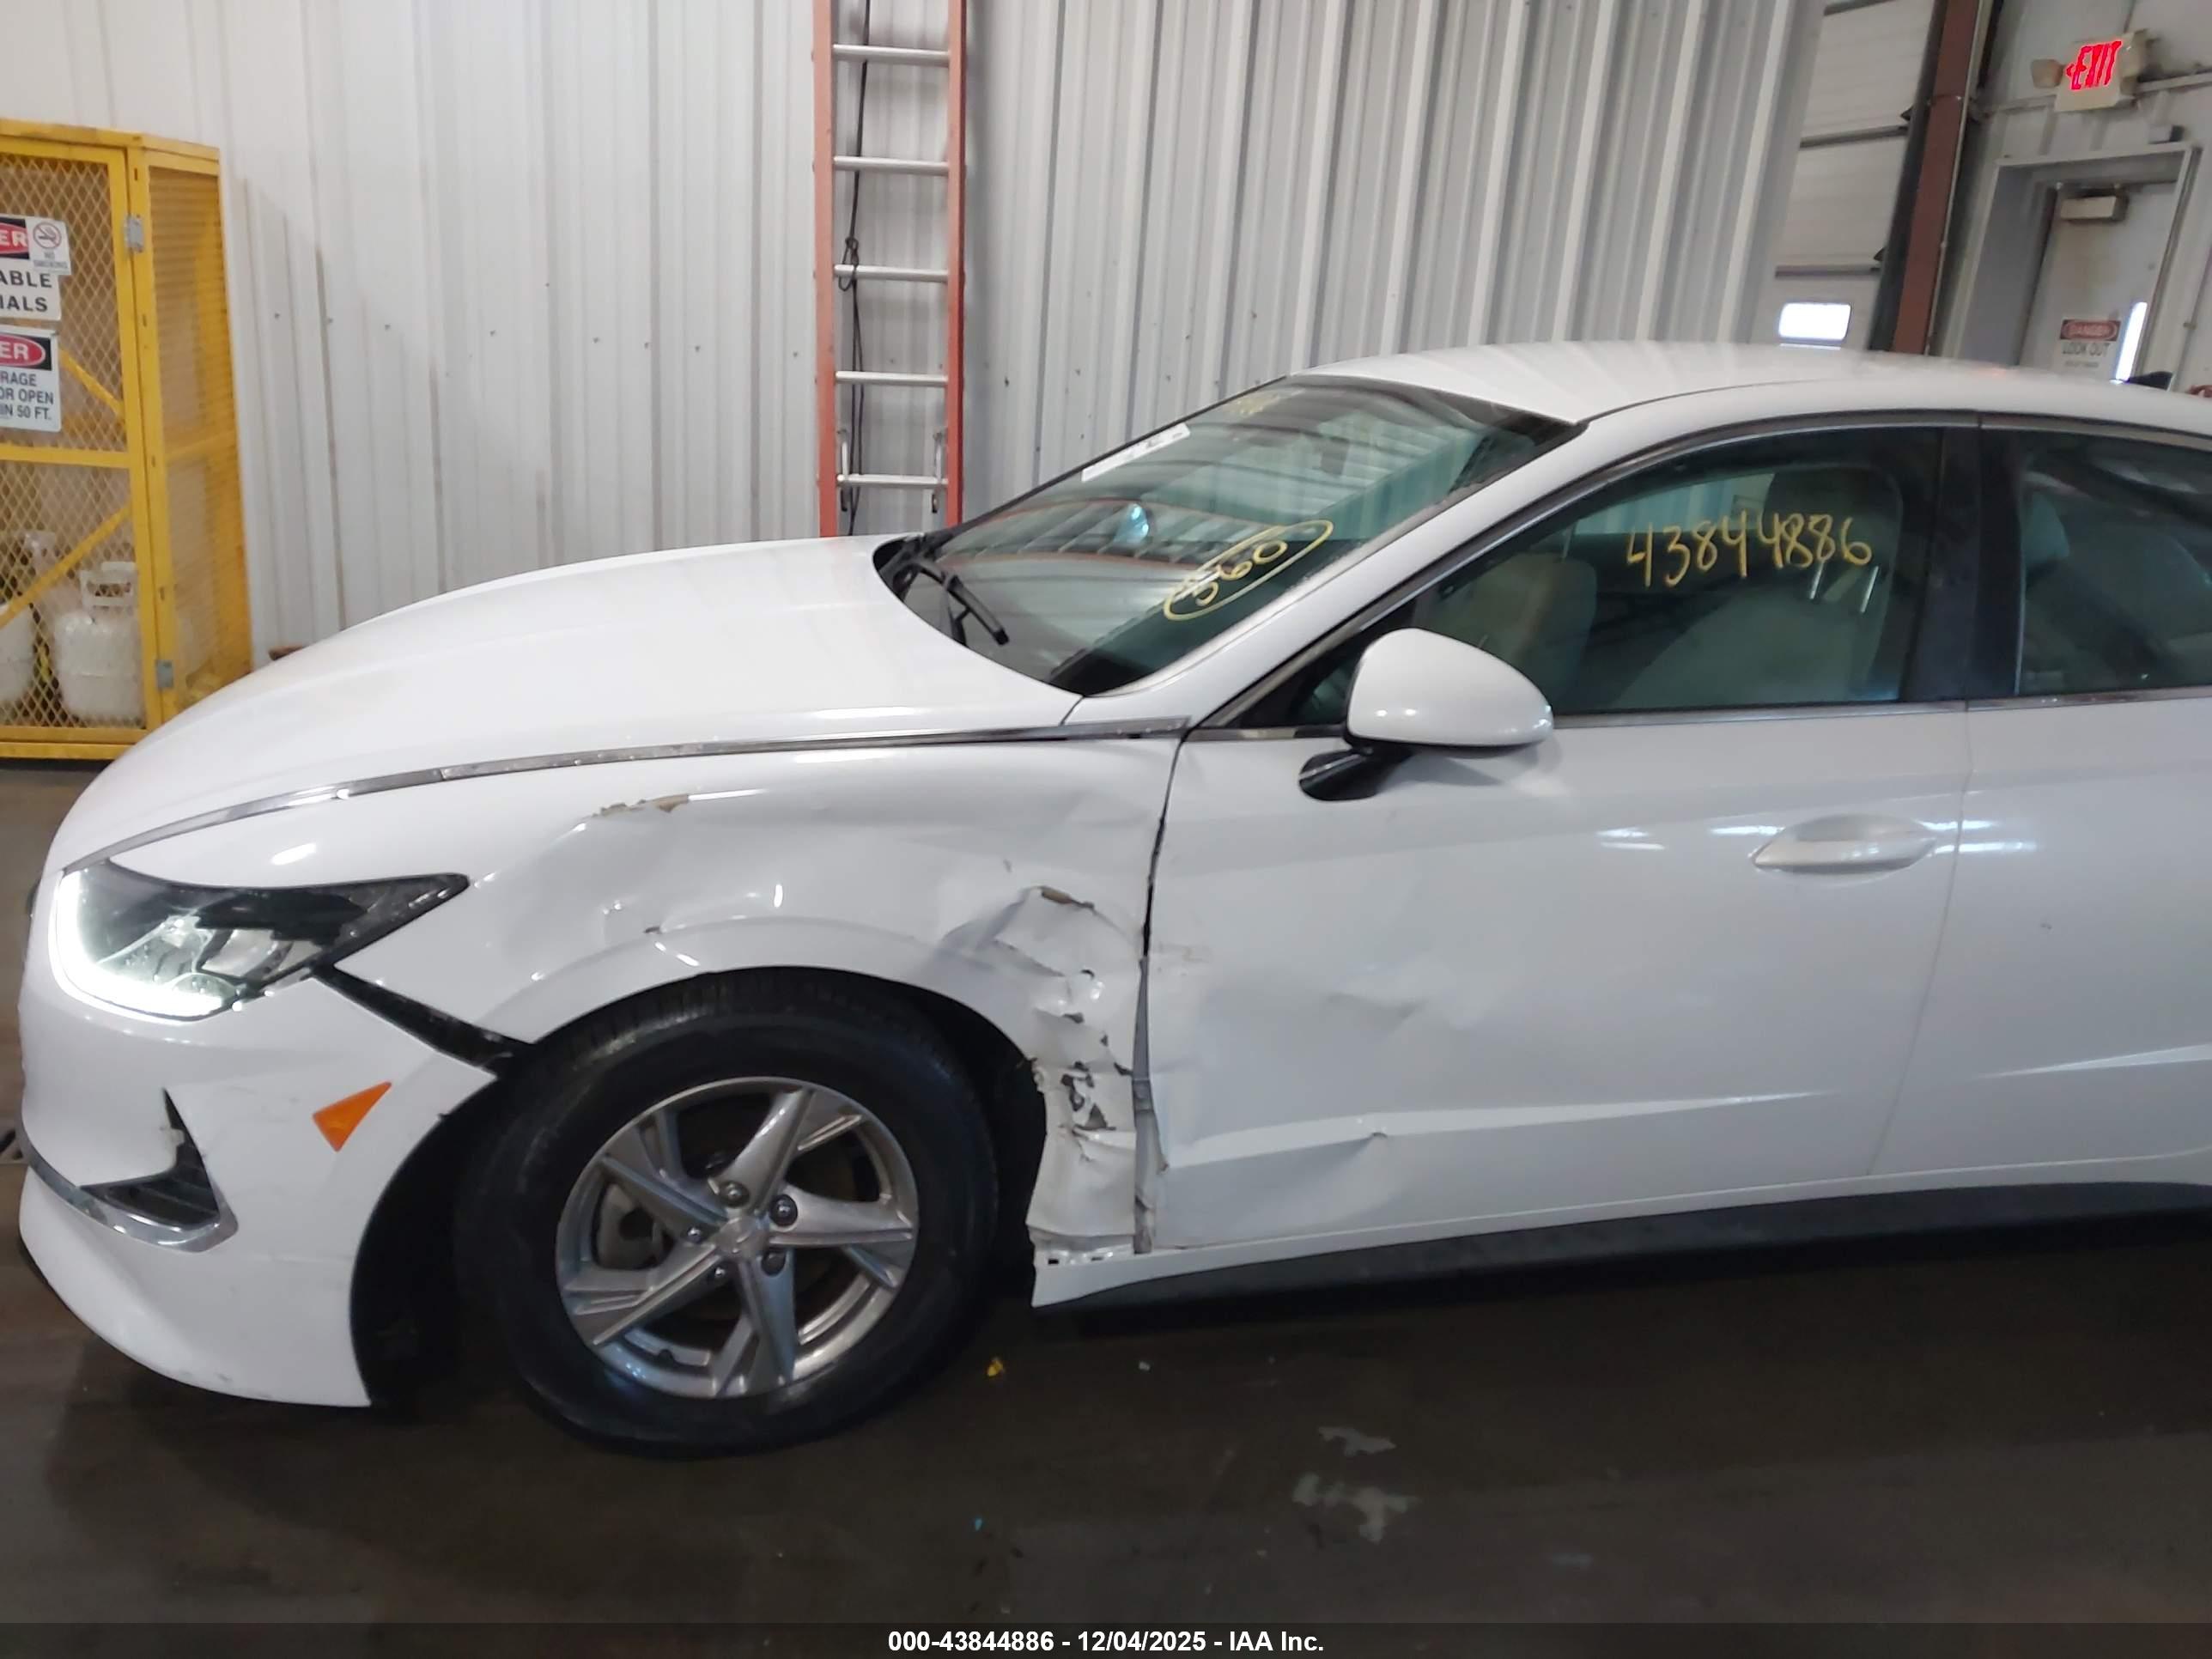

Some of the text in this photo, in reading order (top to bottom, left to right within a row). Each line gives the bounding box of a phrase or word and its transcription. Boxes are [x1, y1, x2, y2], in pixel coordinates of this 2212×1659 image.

[2070, 40, 2123, 91] EXIT
[17, 404, 31, 418] 50
[18, 388, 54, 404] OPEN
[1626, 508, 1873, 587] 43844886
